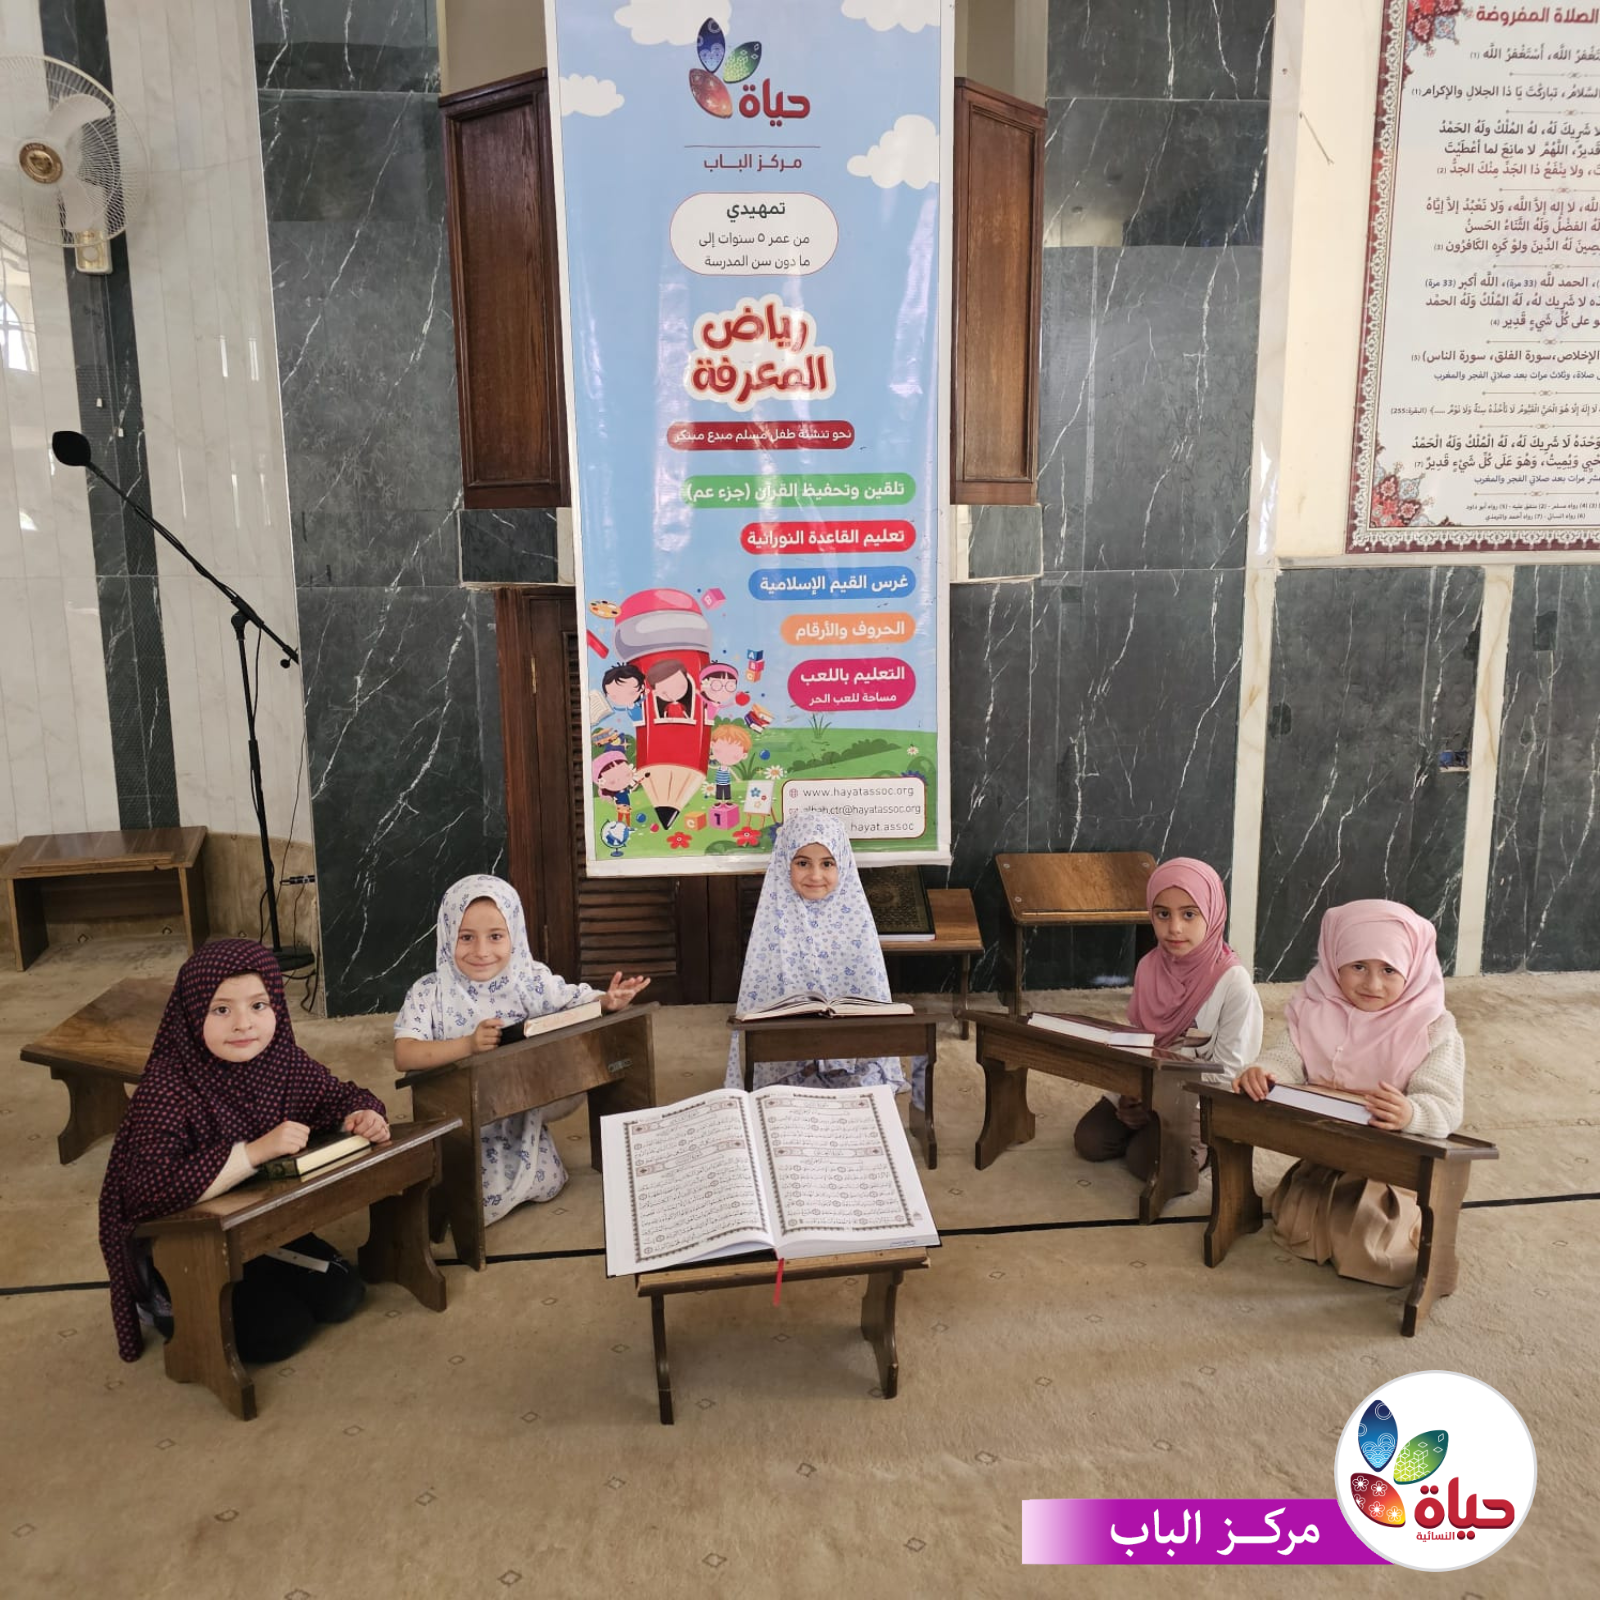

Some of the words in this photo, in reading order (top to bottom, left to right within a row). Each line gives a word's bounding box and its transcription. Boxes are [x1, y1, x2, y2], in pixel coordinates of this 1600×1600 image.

[1476, 6, 1550, 26] المفروضة
[1554, 8, 1599, 24] الصلاة
[739, 78, 810, 127] حياة
[704, 154, 752, 173] الباب
[757, 154, 802, 173] مركز
[727, 202, 785, 223] تمهيدي
[699, 232, 715, 248] إلى
[718, 232, 755, 247] سنوات
[768, 235, 790, 247] عمر
[793, 237, 810, 247] من
[704, 255, 748, 270] المدرسة
[751, 259, 771, 270] سن
[775, 259, 796, 270] دون
[799, 255, 810, 266] ما
[1558, 277, 1588, 287] الحمد
[703, 302, 808, 351] رياض
[1459, 350, 1486, 364] سورة
[692, 354, 827, 403] المعرفة
[735, 429, 768, 444] مسلم
[832, 429, 851, 441] نحو
[802, 483, 859, 499] وتحفيظ
[864, 481, 905, 499] تلقين
[809, 530, 859, 544] القاعدة
[863, 529, 905, 546] تعليم
[760, 576, 825, 595] الإسلامية
[830, 575, 866, 593] القيم
[871, 575, 908, 591] غرس
[795, 622, 847, 640] والأرقام
[852, 621, 905, 638] الحروف
[800, 669, 849, 685] باللعب
[853, 667, 905, 685] التعليم
[809, 694, 830, 706] الحر
[833, 693, 859, 704] للعب
[862, 693, 896, 702] مساحة
[803, 787, 914, 798] www.hayatassoc.org
